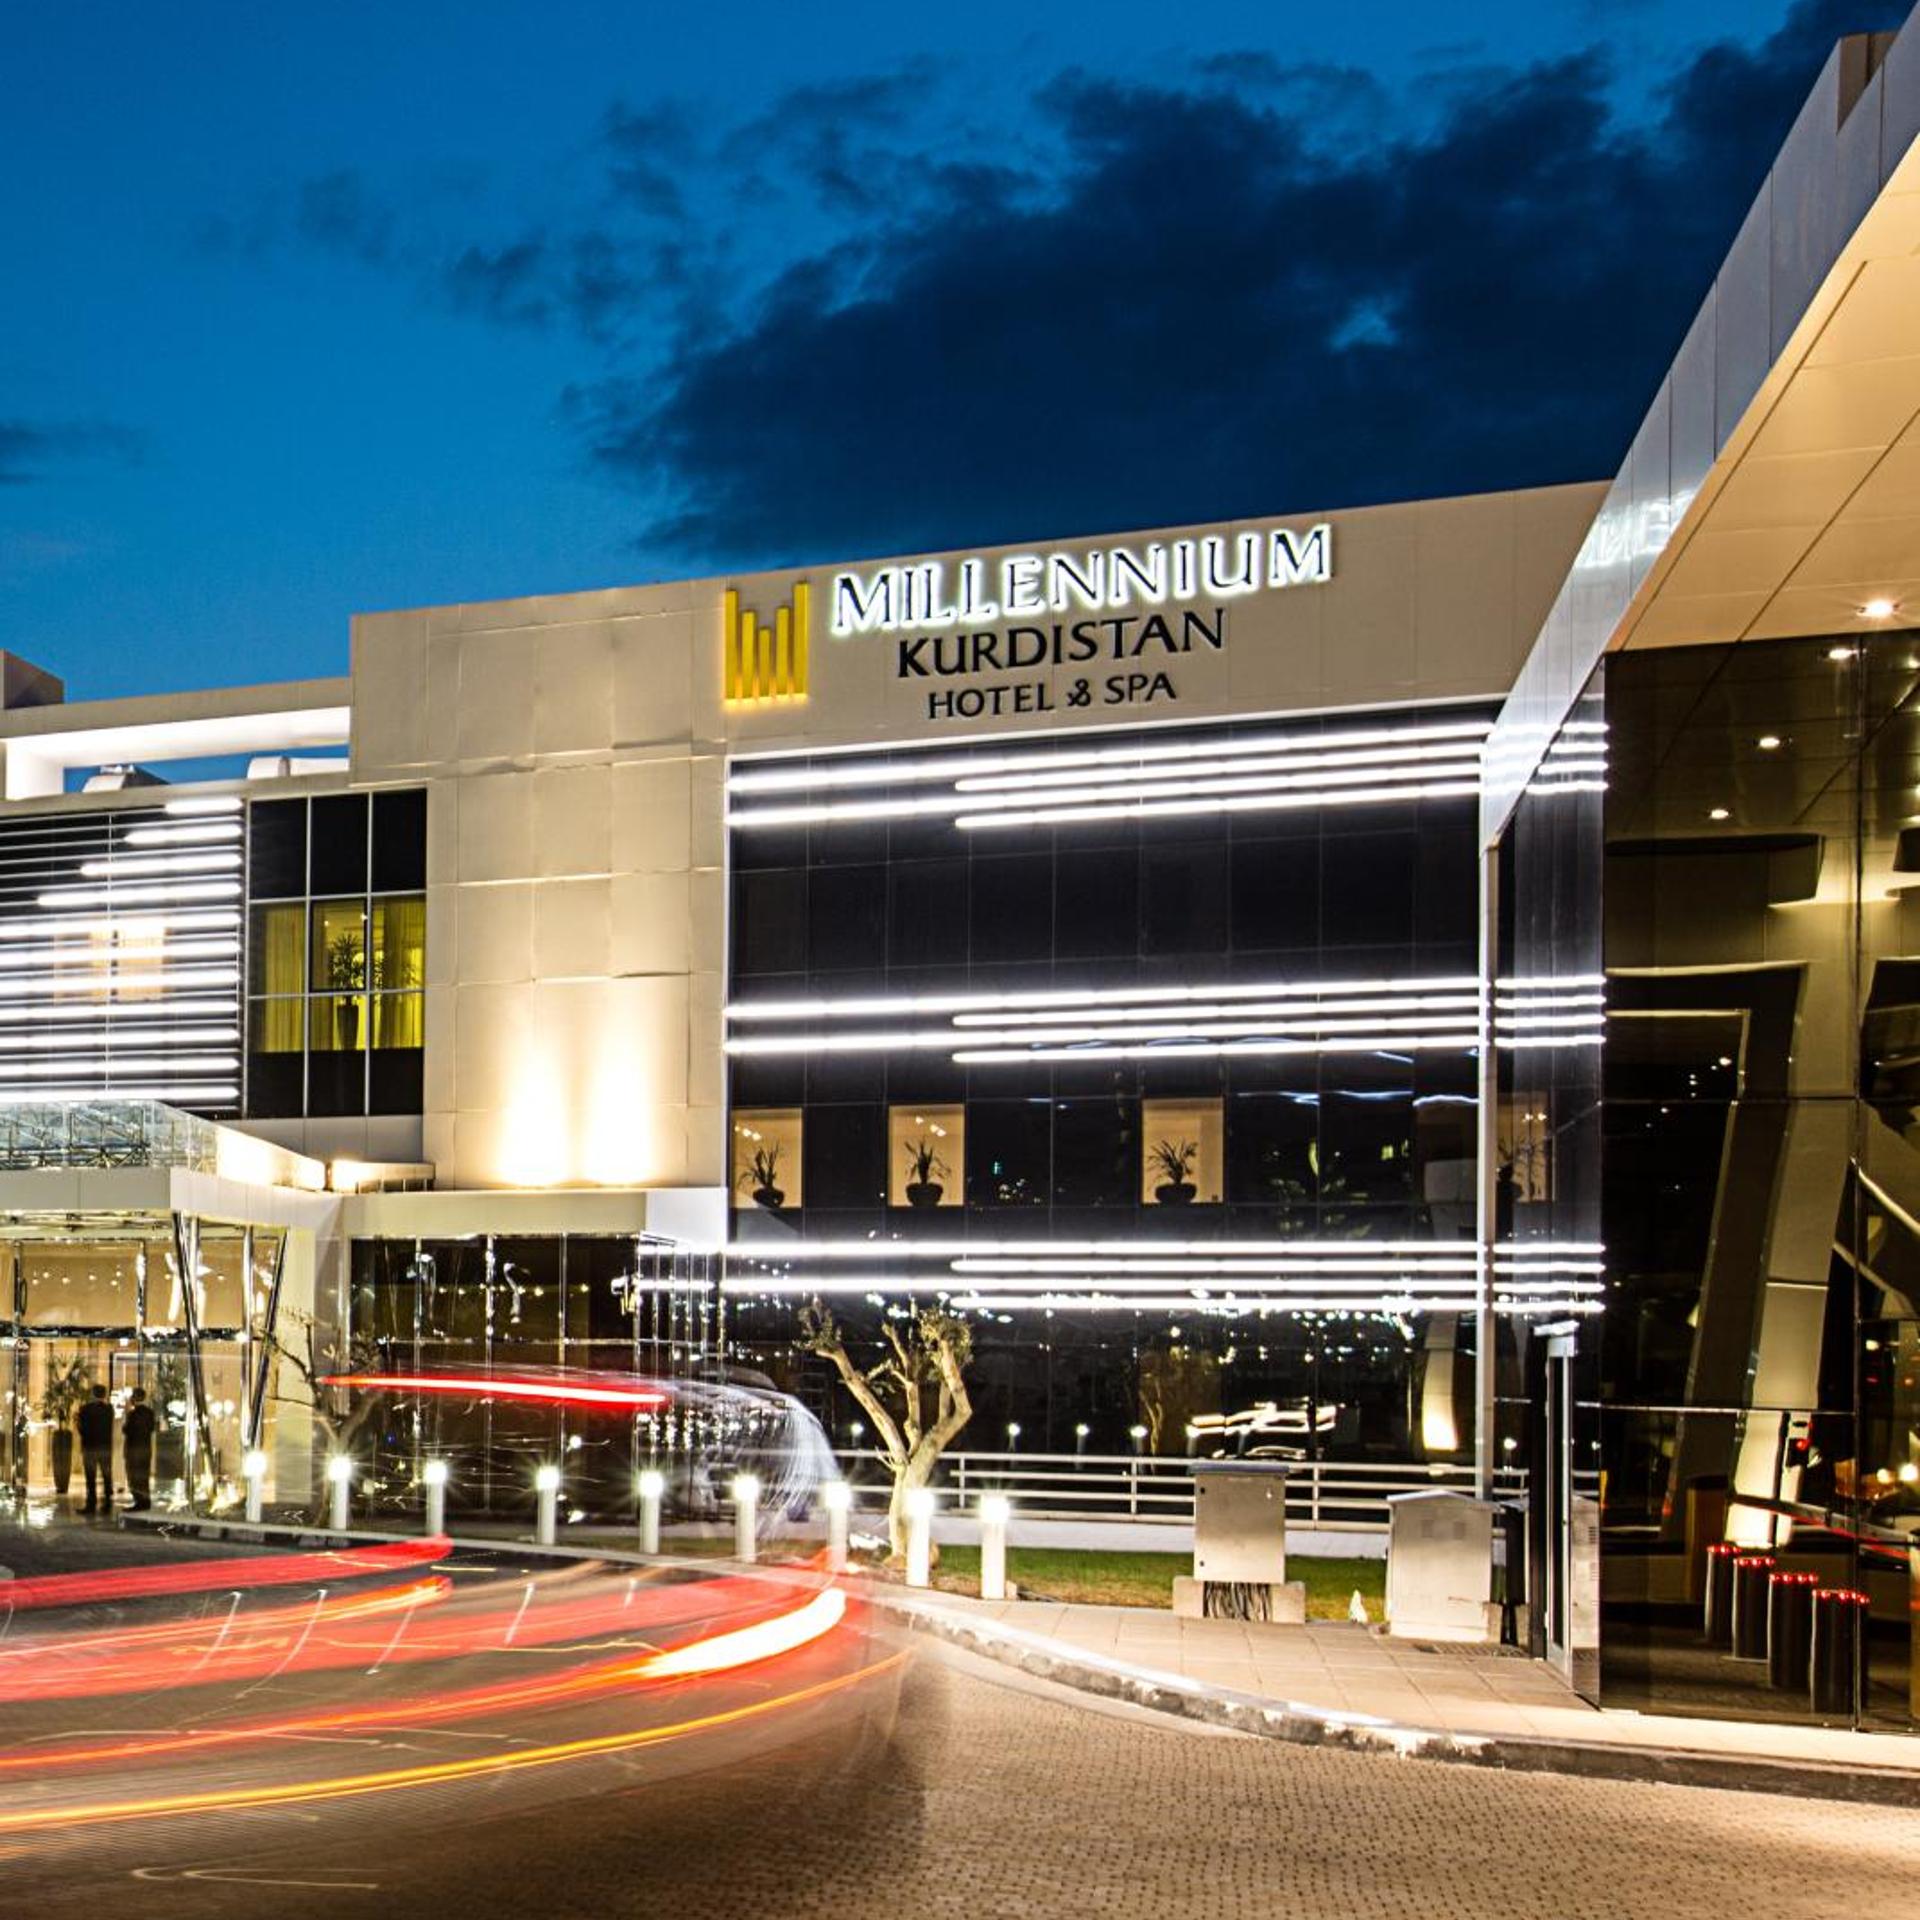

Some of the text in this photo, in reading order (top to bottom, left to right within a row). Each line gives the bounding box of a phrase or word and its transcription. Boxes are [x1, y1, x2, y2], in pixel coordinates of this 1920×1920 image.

[832, 524, 1332, 634] MILLENNIUM
[898, 607, 1225, 678] KURDISTAN
[928, 673, 1177, 720] HOTEL & SPA
